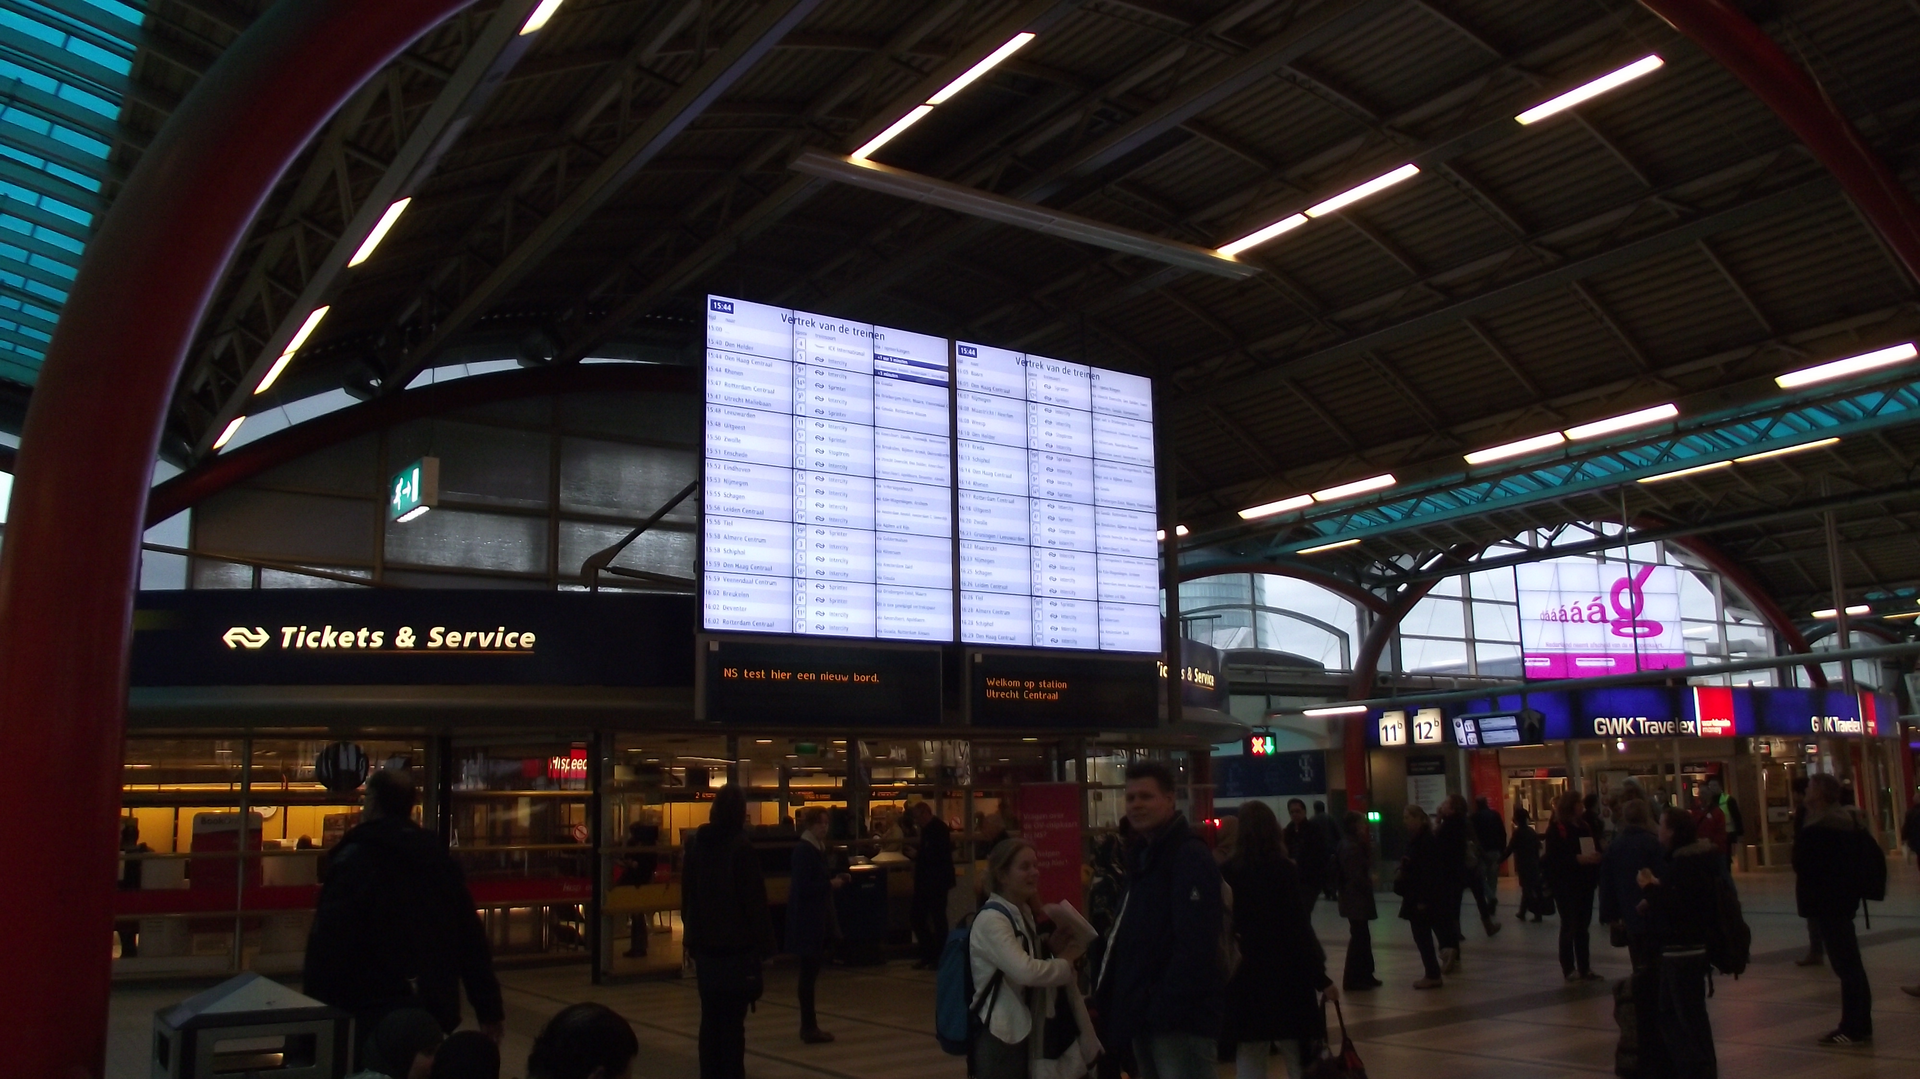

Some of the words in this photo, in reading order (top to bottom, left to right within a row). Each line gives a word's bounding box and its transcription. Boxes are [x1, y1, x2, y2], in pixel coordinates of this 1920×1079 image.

[714, 302, 732, 312] 15:44
[781, 313, 816, 328] Vertrek
[819, 322, 835, 332] van
[838, 324, 849, 334] de
[853, 328, 885, 340] treinen
[960, 347, 976, 356] 15:44
[1015, 357, 1044, 369] Vertrek
[1062, 366, 1071, 375] de
[1074, 368, 1100, 380] treinen
[281, 625, 384, 648] Tickets
[395, 626, 416, 648] &
[428, 626, 536, 648] Service
[724, 668, 738, 678] NS
[744, 669, 765, 679] test
[771, 670, 792, 680] hier
[797, 672, 816, 680] een
[820, 672, 849, 681] nieuw
[854, 673, 880, 683] bord.
[986, 677, 1020, 688] Welkom
[1024, 681, 1035, 690] op
[1038, 680, 1067, 689] station
[1187, 666, 1192, 681] &
[1195, 668, 1214, 686] Service
[986, 689, 1019, 699] Utrecht
[1024, 690, 1059, 700] Centraal
[1594, 717, 1635, 735] GWK
[1636, 718, 1695, 735] Travelex
[1811, 716, 1833, 732] GK
[1834, 717, 1862, 733] Travelex
